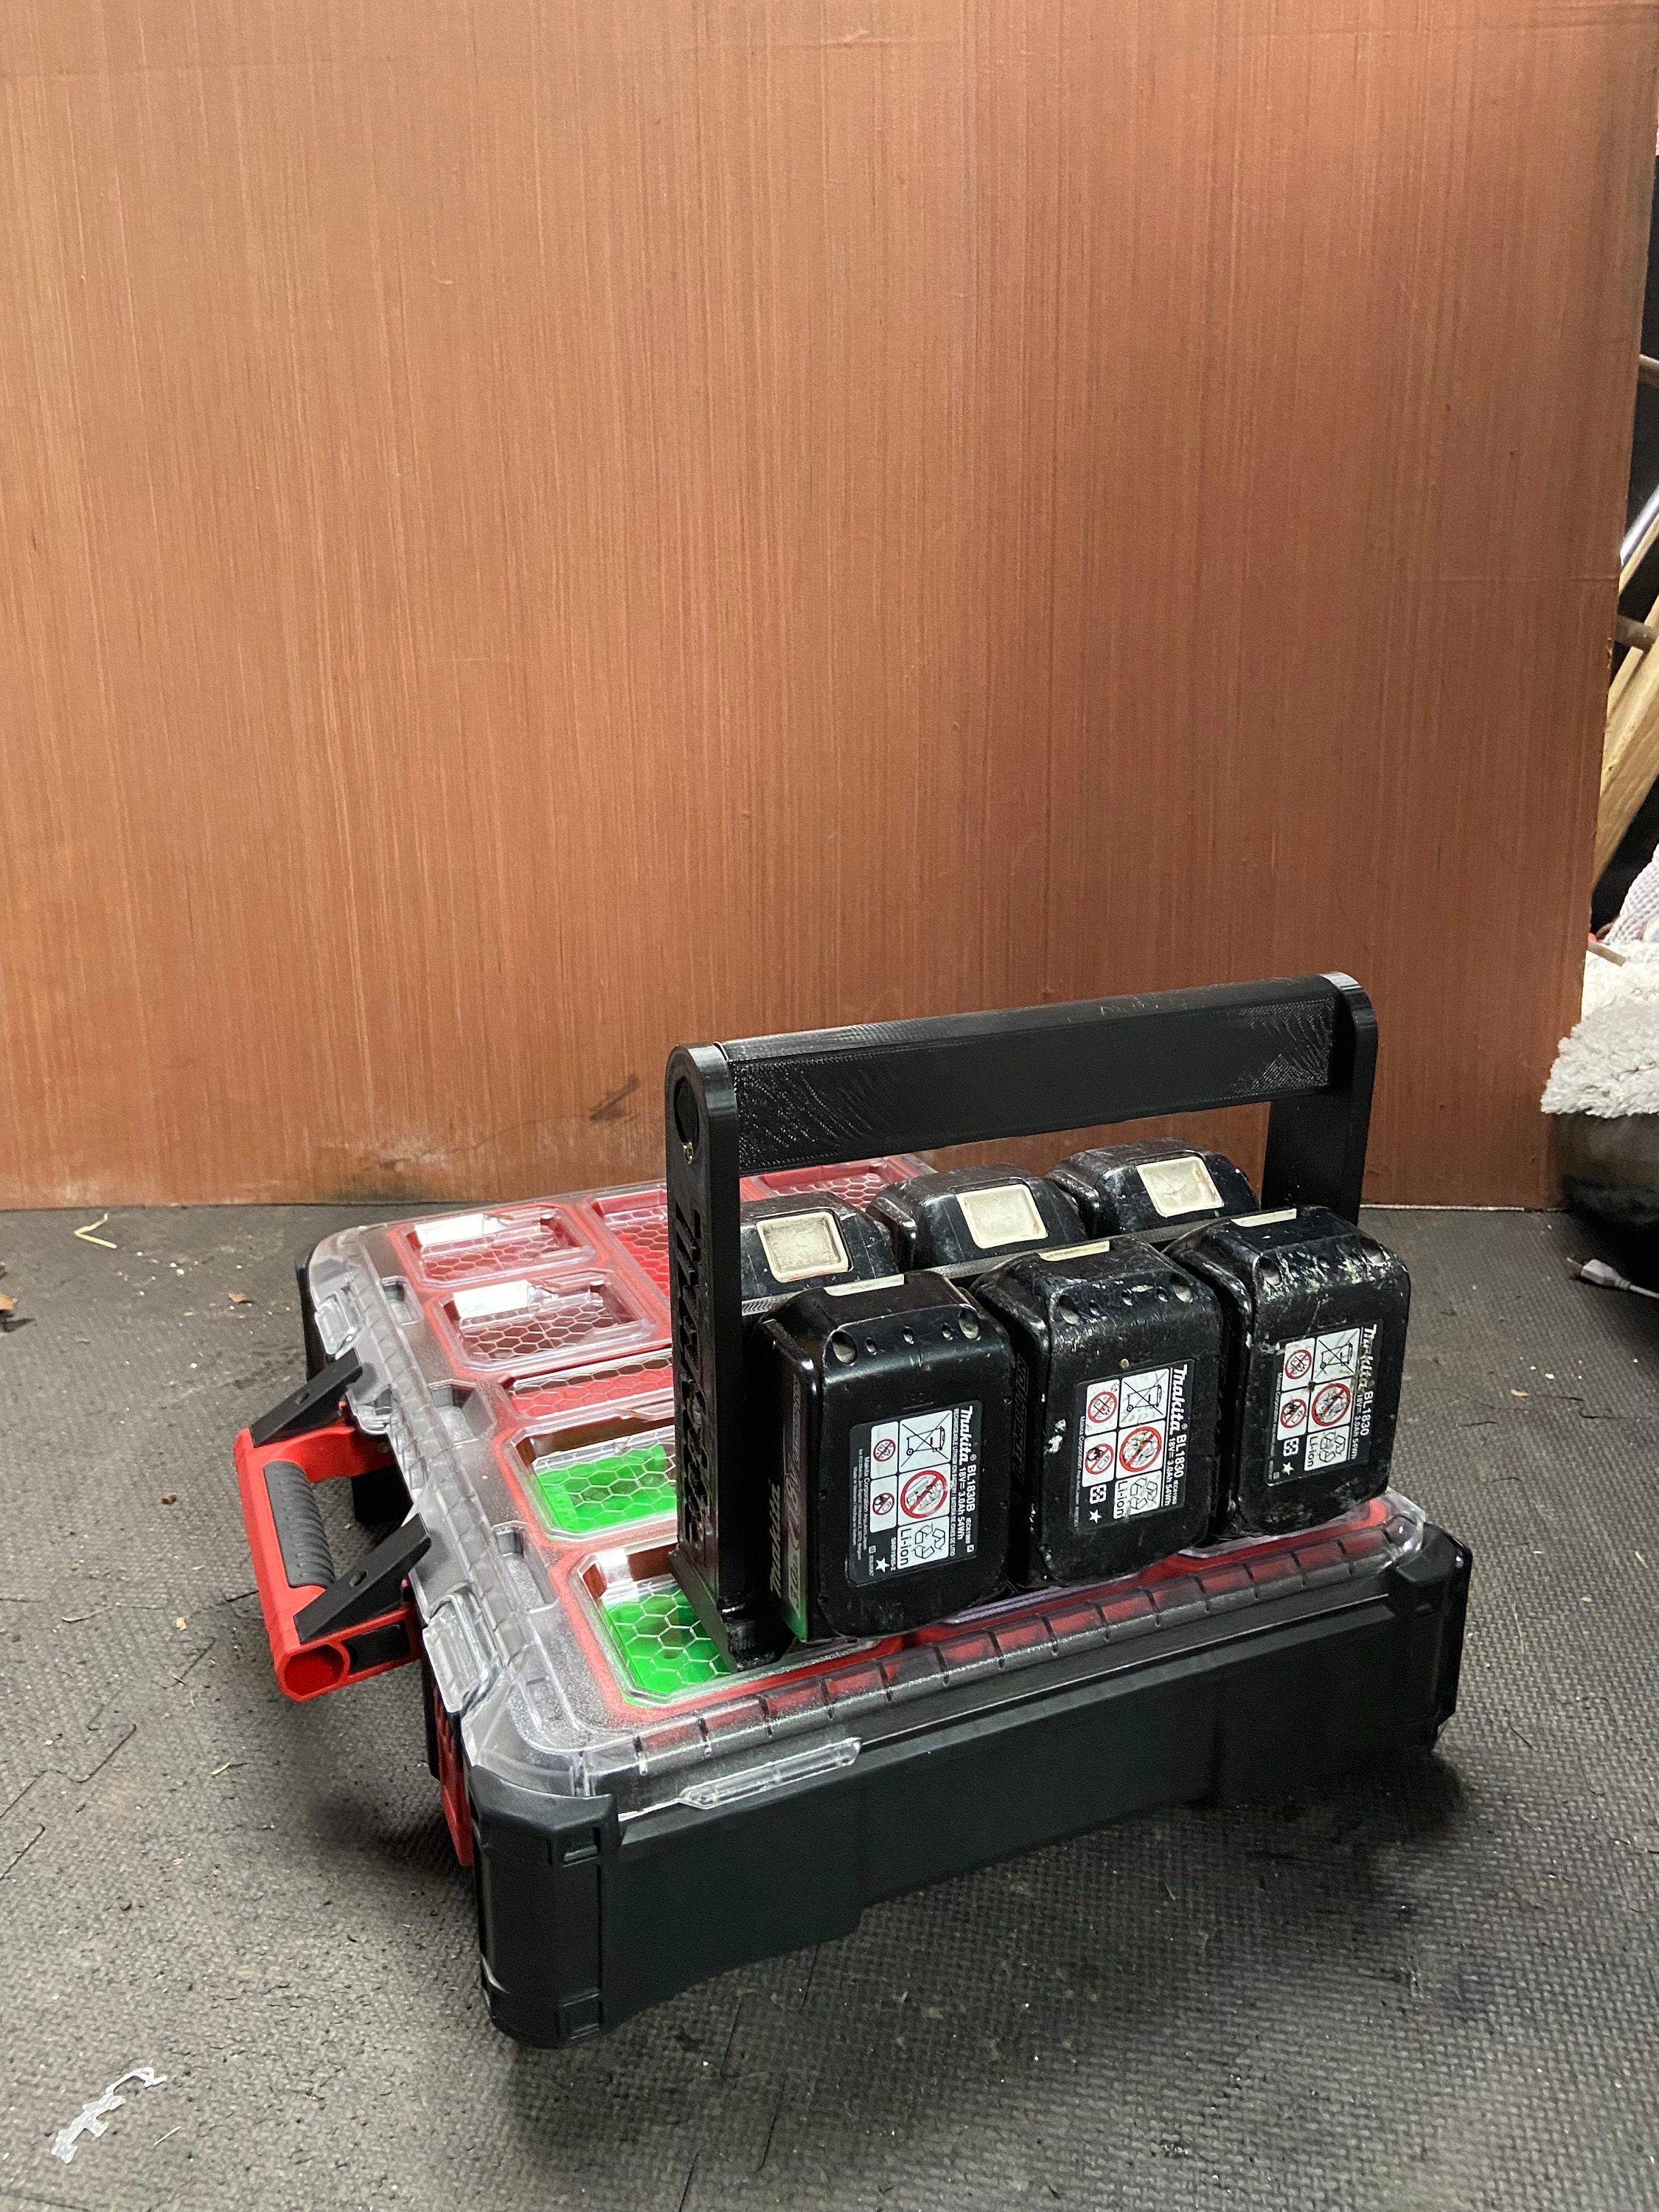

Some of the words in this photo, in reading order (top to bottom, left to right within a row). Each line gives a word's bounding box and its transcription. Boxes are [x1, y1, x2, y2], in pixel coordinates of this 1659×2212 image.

[1360, 1391, 1374, 1436] BL1830
[1174, 1434, 1186, 1478] BL1830
[1307, 1436, 1318, 1467] Li-ion
[967, 1464, 976, 1512] BL1830B
[1116, 1481, 1128, 1516] Li-ion
[900, 1528, 911, 1565] Li-ion
